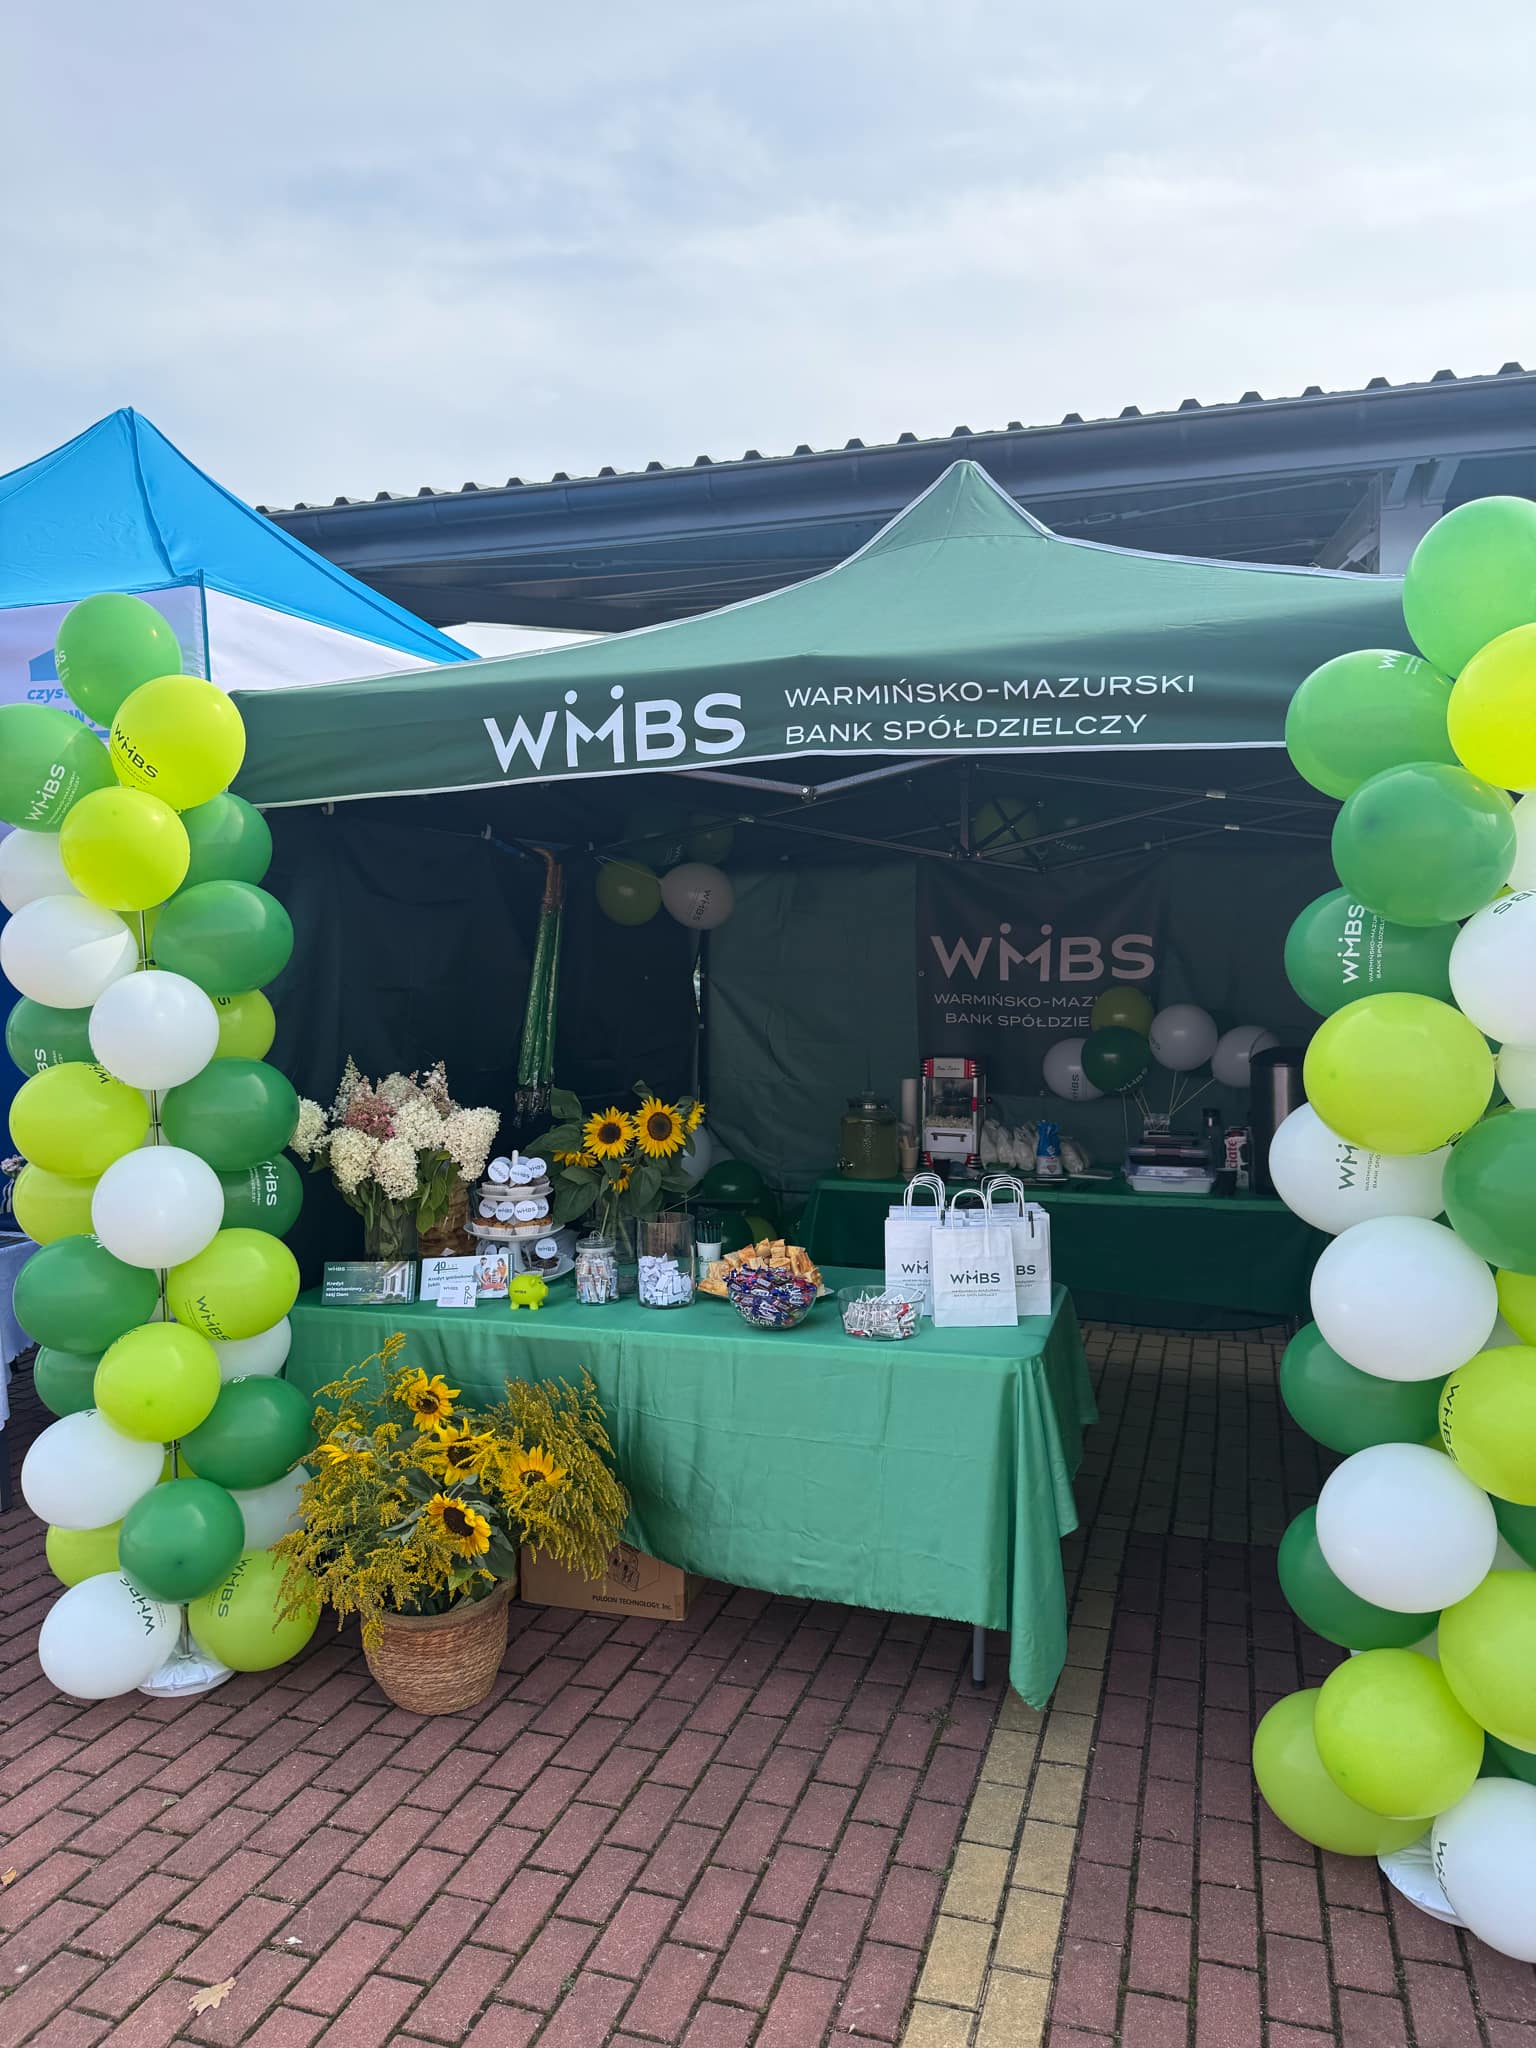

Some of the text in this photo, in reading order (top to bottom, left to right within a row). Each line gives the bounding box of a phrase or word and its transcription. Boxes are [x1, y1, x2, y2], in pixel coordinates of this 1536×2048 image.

[785, 675, 1194, 708] WARMIŃSKO-MAZURSKI
[115, 723, 159, 778] WMBS
[483, 685, 746, 774] WMBS
[786, 713, 1148, 745] BANK SPÓŁDZIELCZY
[24, 763, 66, 821] WMBS
[930, 922, 1155, 982] WMBS
[1337, 904, 1365, 984] WMBS
[934, 993, 1098, 1008] WARMIŃSKO-MAZ
[945, 1013, 993, 1025] BANK
[950, 1269, 1001, 1284] WMBS
[196, 1295, 232, 1341] WMBS
[218, 1558, 253, 1617] WMBS
